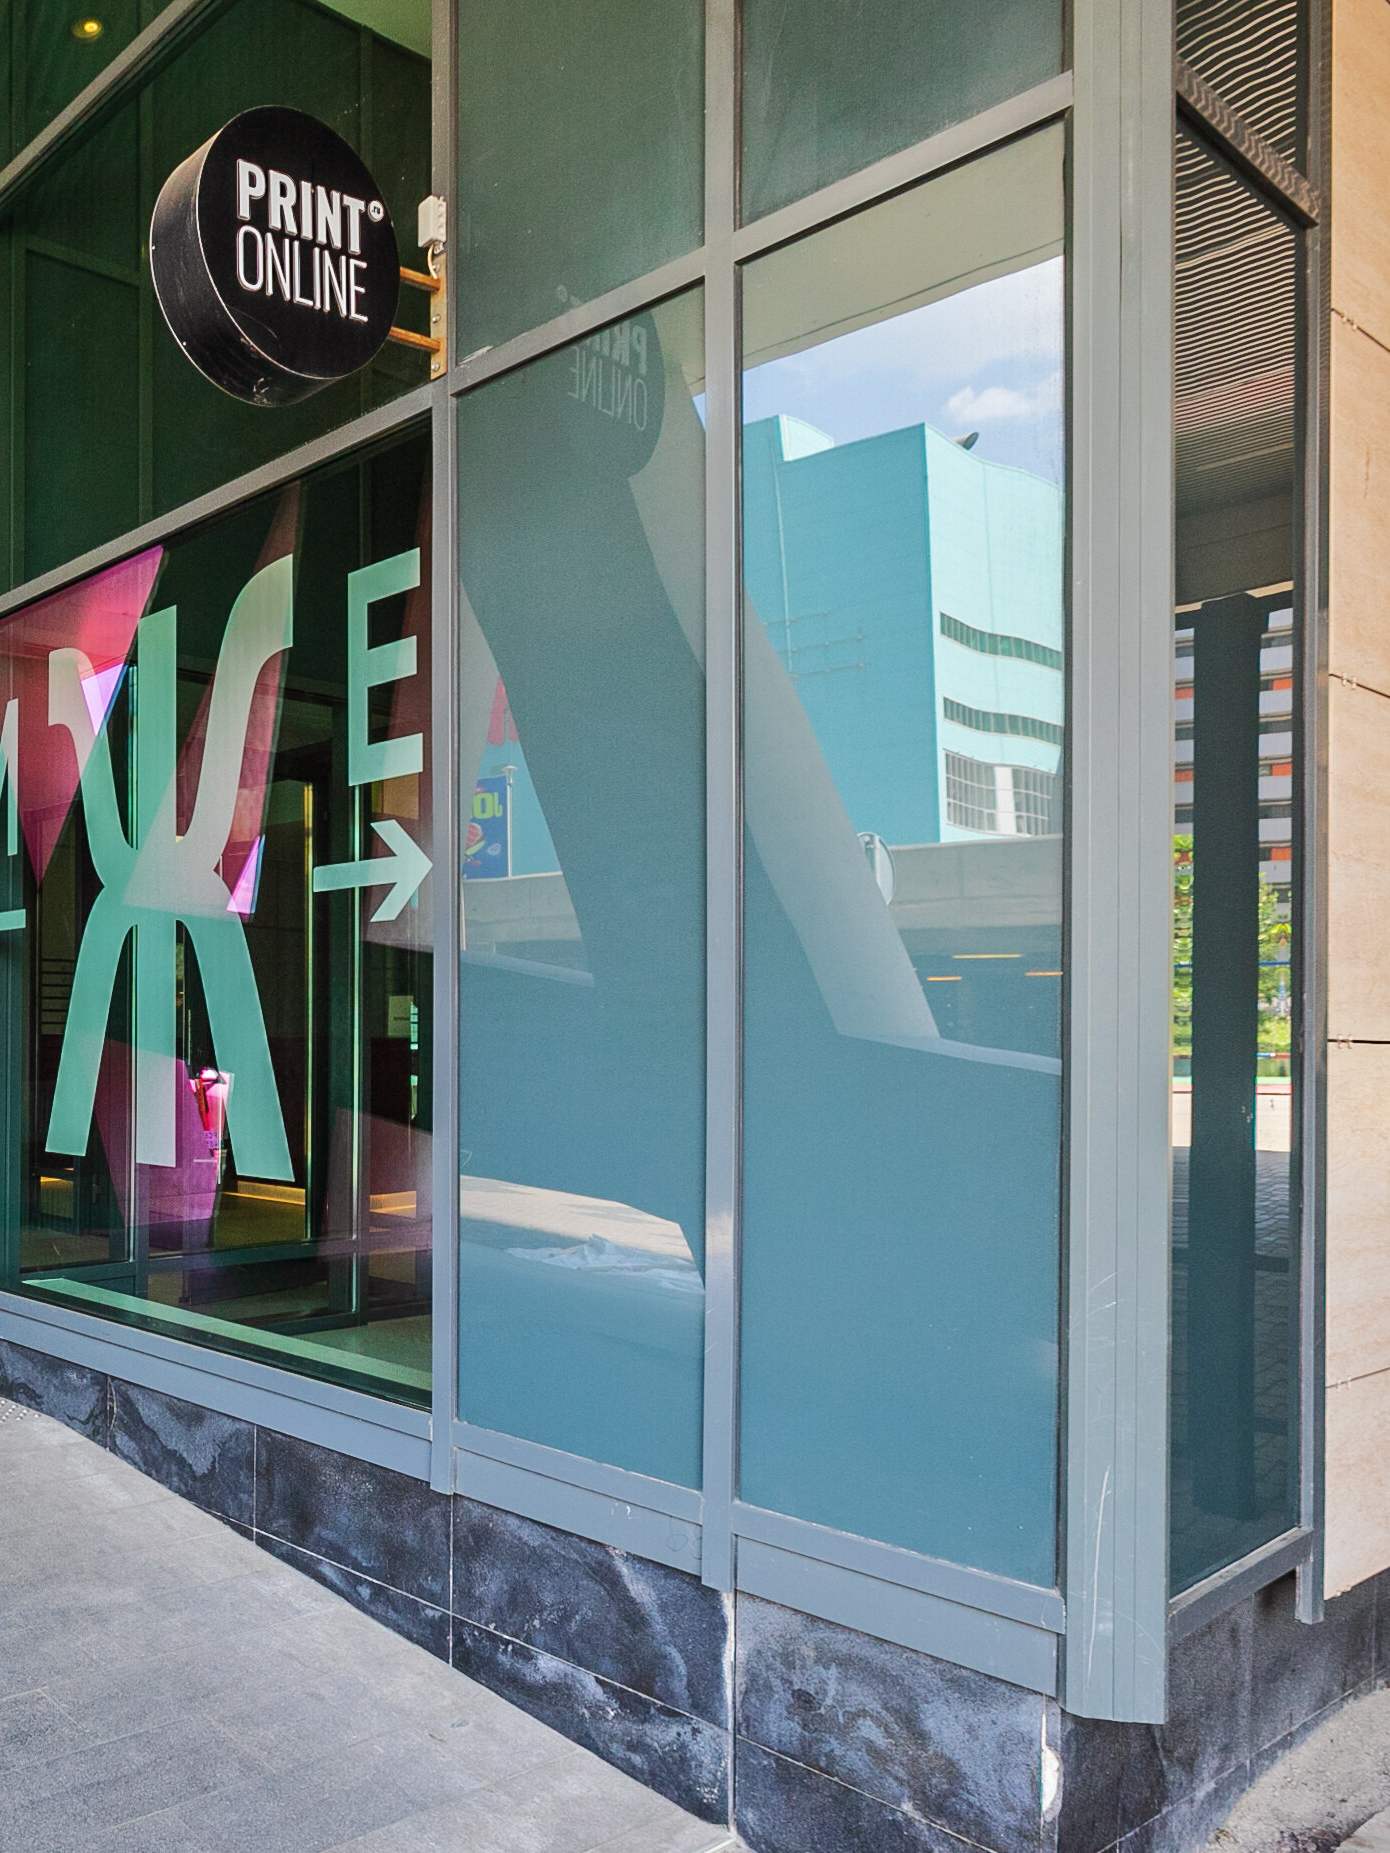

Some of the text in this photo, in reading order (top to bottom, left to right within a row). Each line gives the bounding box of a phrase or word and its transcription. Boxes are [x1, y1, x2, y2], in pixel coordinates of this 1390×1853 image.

[237, 159, 367, 255] PRINT
[237, 226, 368, 323] ONLINE
[45, 553, 294, 1183] Ж
